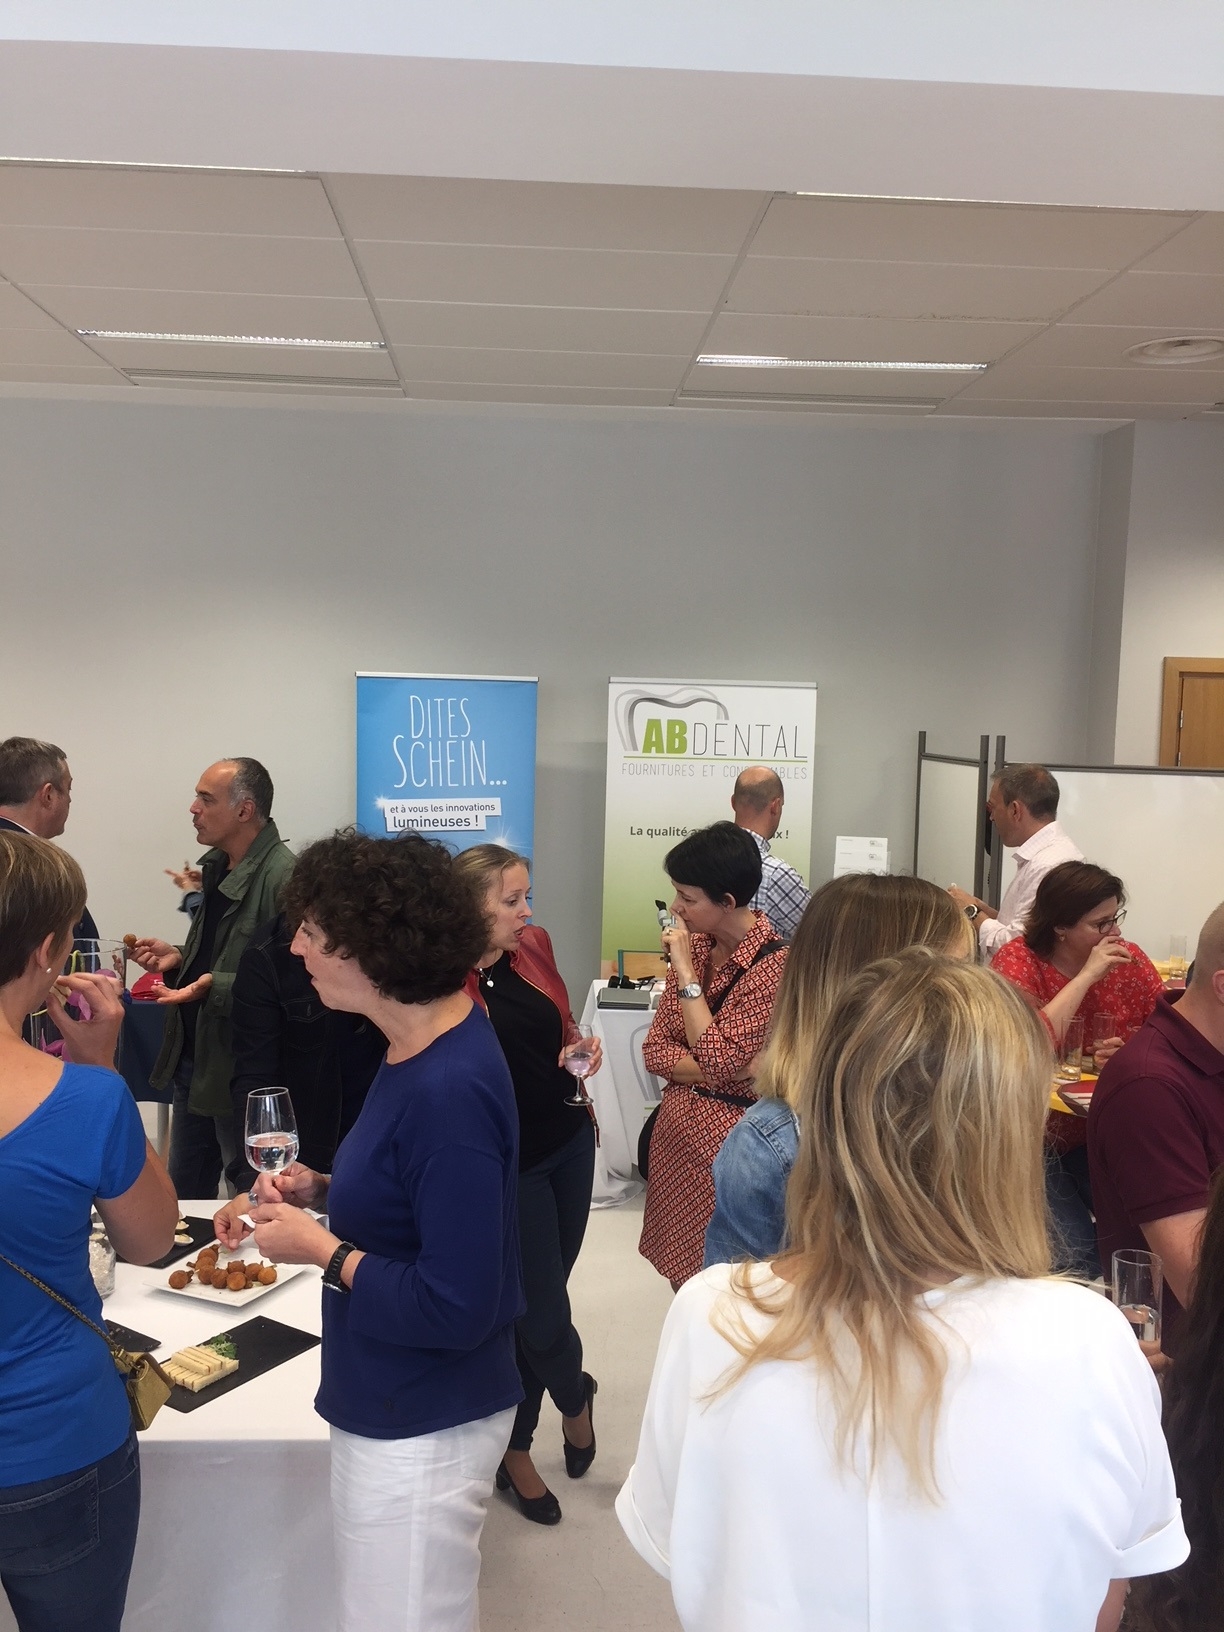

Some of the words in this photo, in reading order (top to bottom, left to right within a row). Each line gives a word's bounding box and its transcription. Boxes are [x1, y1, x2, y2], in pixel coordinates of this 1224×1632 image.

[410, 695, 471, 738] DITES
[393, 735, 507, 788] SCHEIN...
[621, 762, 695, 777] FOURNITURES
[702, 764, 716, 777] ET
[390, 804, 399, 814] et
[400, 803, 407, 813] à
[409, 805, 429, 813] vous
[430, 804, 444, 813] les
[445, 802, 496, 812] innovations
[393, 815, 471, 828] lumineuses
[630, 826, 643, 836] La
[646, 825, 688, 840] qualité
